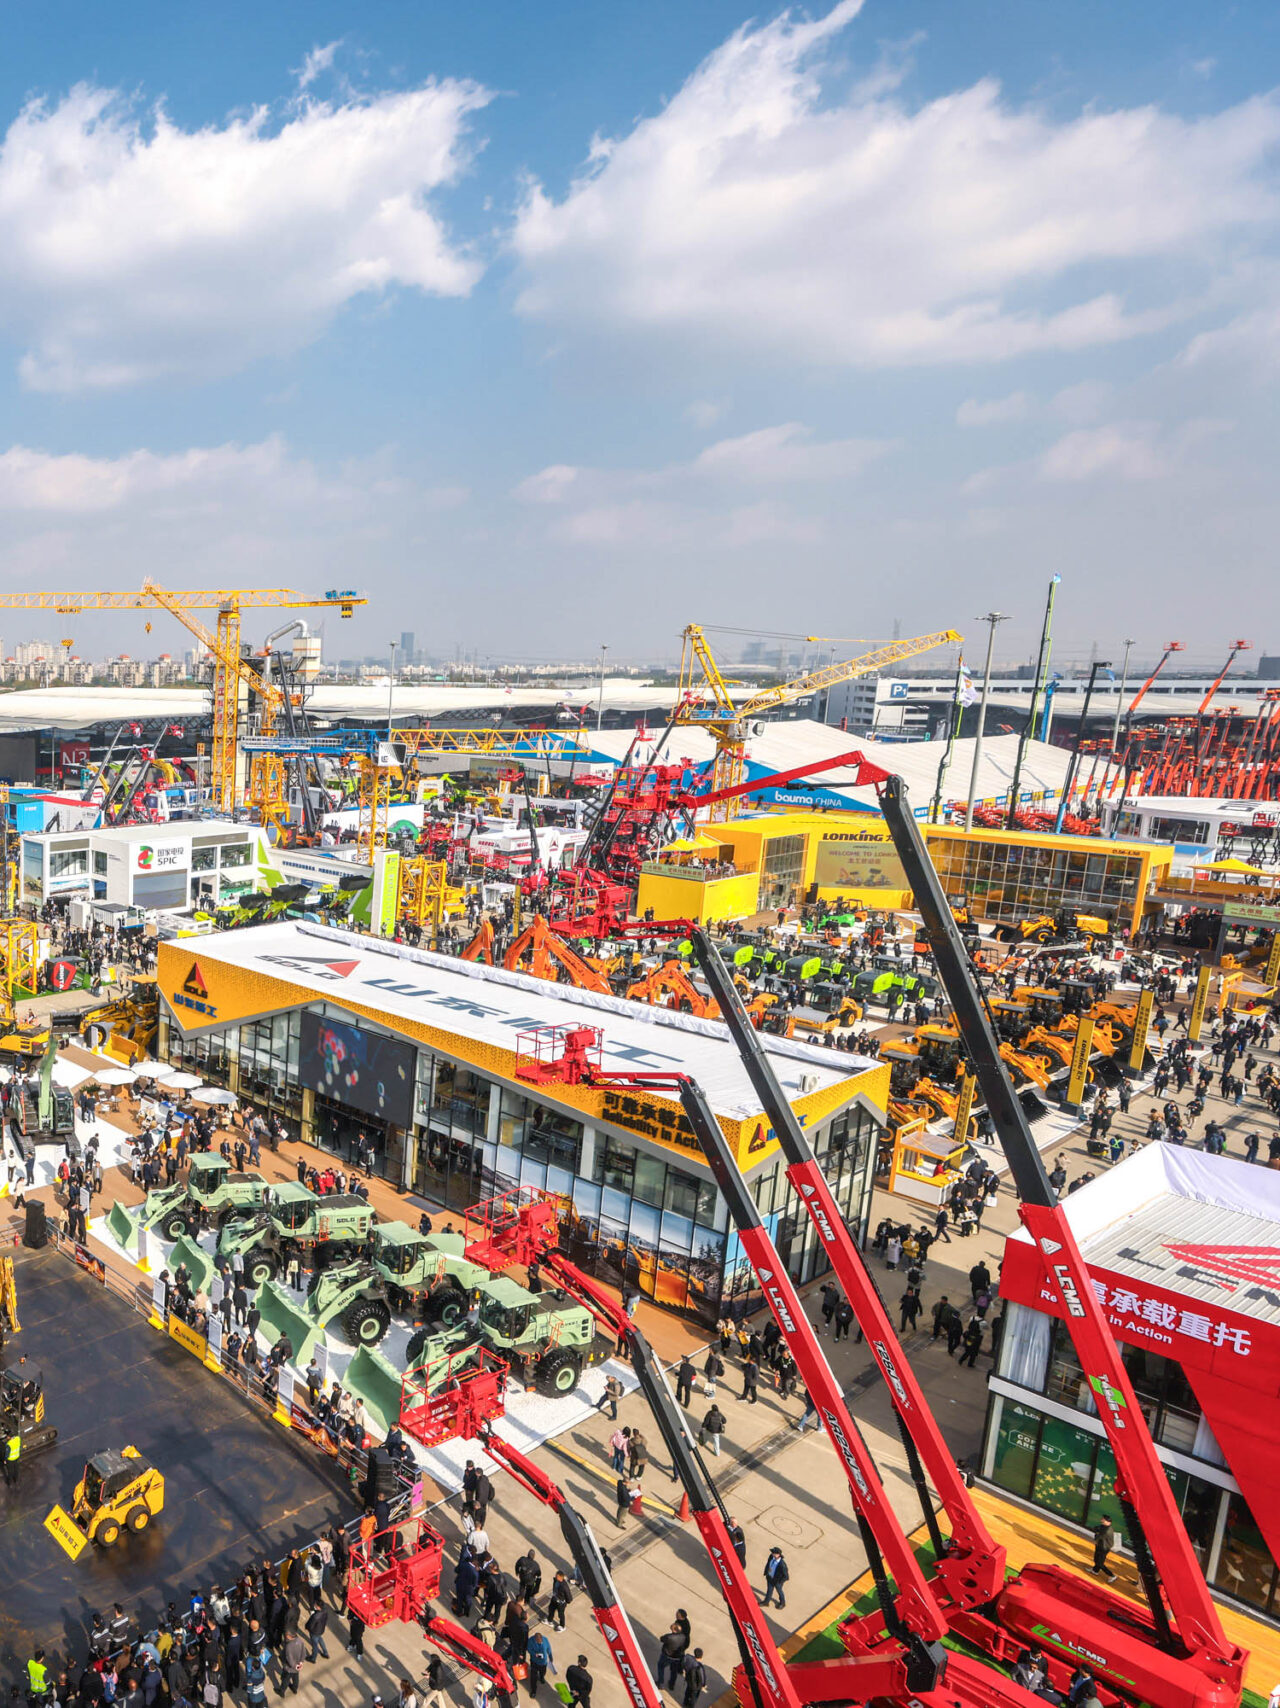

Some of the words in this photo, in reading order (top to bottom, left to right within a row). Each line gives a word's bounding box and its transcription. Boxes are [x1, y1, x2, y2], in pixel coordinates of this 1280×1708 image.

[893, 686, 907, 697] P1
[775, 790, 813, 805] bauma
[815, 797, 842, 807] CHINA
[157, 856, 177, 866] SPIC
[1125, 1320, 1173, 1344] Action
